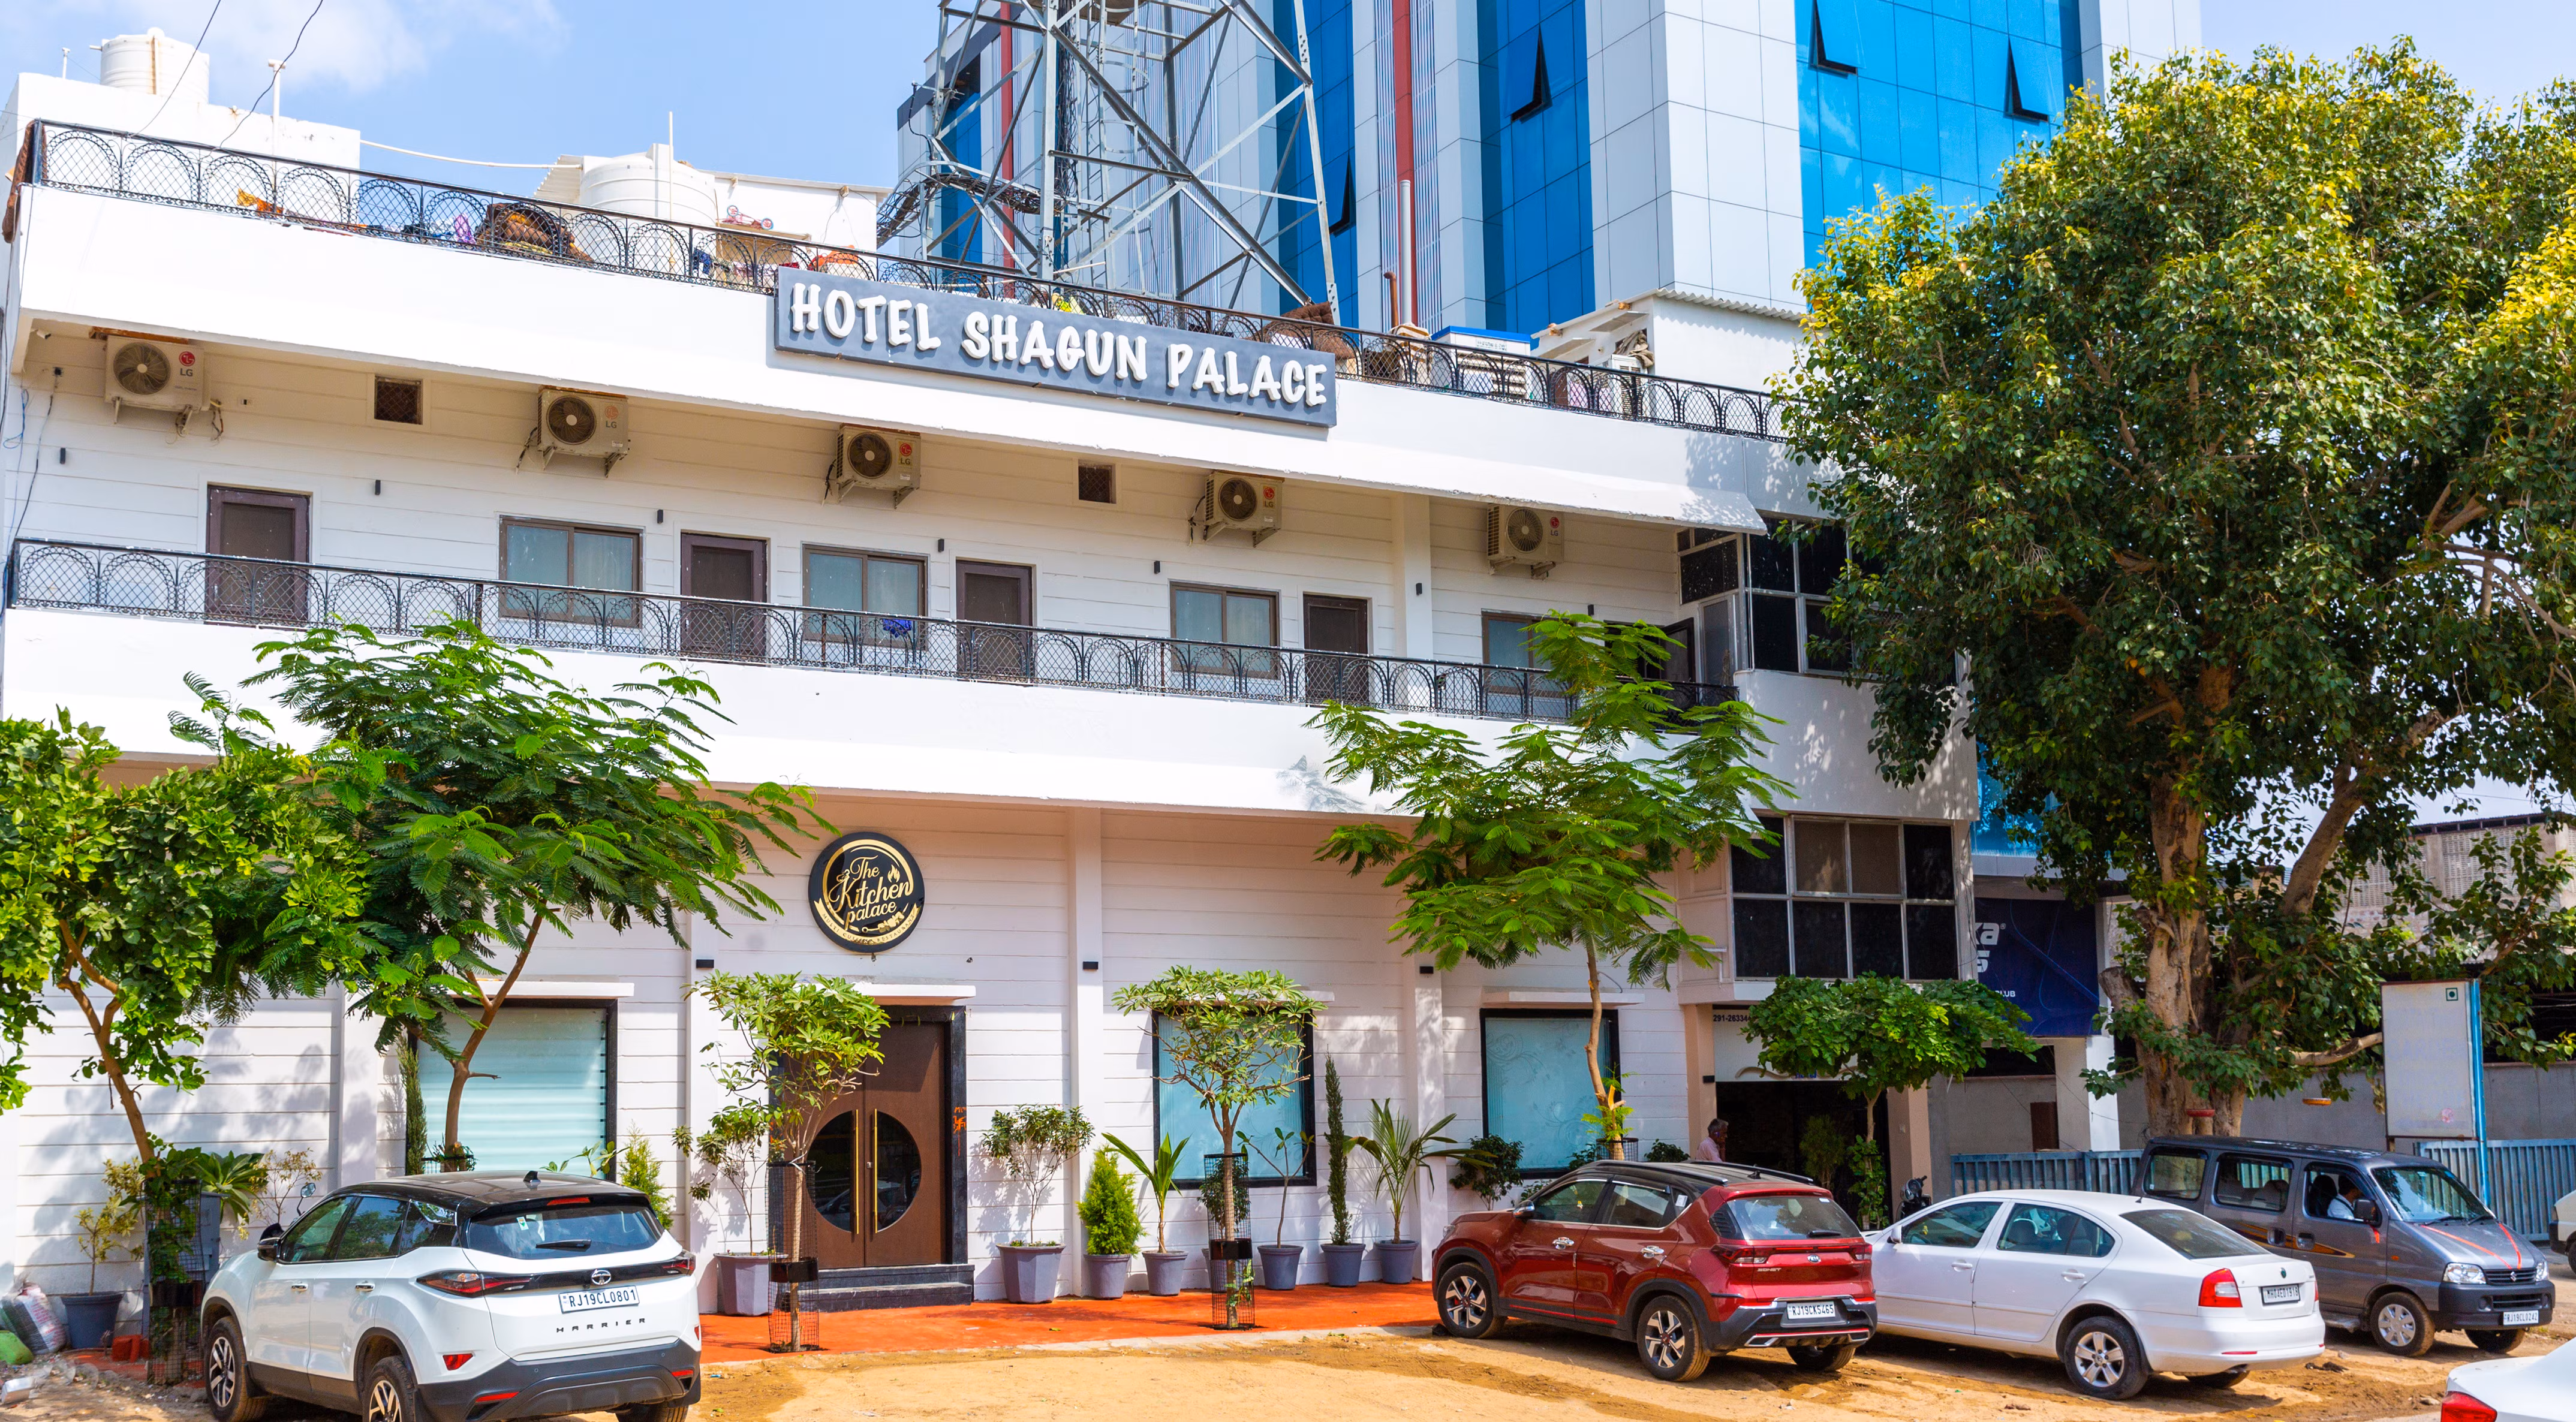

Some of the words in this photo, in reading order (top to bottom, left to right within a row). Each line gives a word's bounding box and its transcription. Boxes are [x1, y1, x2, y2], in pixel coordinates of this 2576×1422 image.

[791, 283, 941, 351] HOTEL
[961, 311, 1148, 381] SHAGUN
[1167, 344, 1327, 407] PALACE
[180, 368, 193, 377] LG
[850, 855, 880, 879] The
[829, 876, 913, 913] Kitchen
[822, 913, 839, 933] MULTI
[845, 900, 898, 931] palace
[569, 1290, 636, 1307] RJ19CL0801
[556, 1318, 645, 1333] HARRIER
